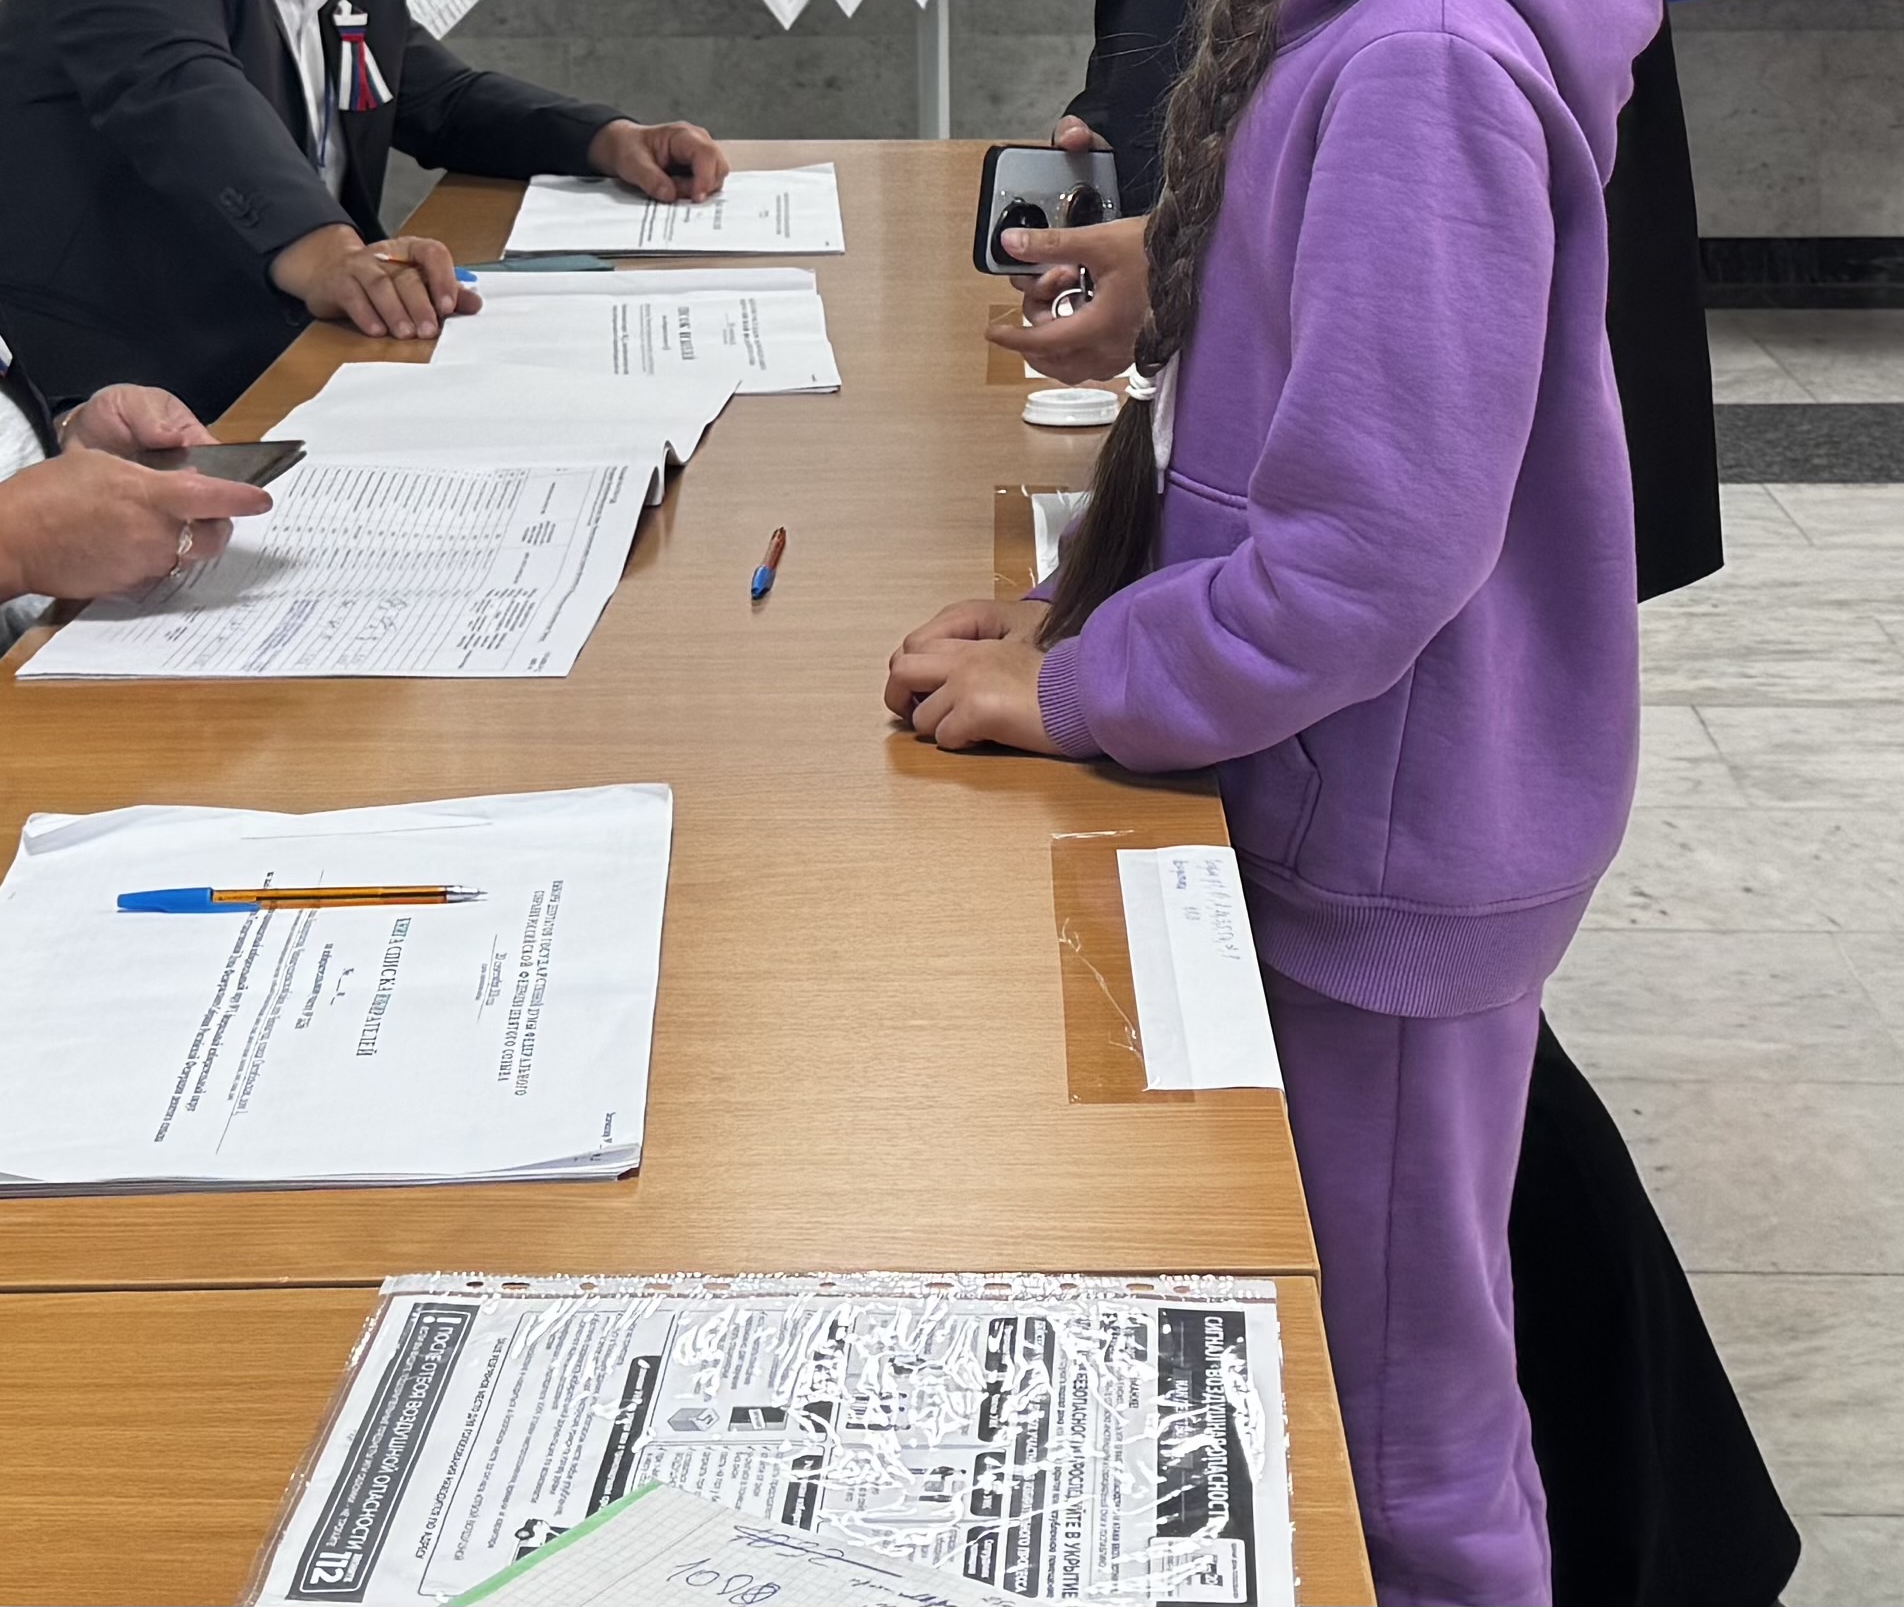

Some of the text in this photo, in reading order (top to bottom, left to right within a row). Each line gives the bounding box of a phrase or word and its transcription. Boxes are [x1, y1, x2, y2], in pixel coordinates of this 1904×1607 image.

[377, 946, 402, 992] СПИСКА
[1204, 1317, 1224, 1361] СИГНАЛ
[471, 1390, 489, 1413] МЕСТО
[345, 1326, 453, 1550] ПОСЛЕ ОТБОЯ ВОЗДУШНОЙ ОПАСНОСТИ
[309, 1551, 353, 1585] 112
[1061, 1543, 1081, 1598] УКРЫТИЕ
